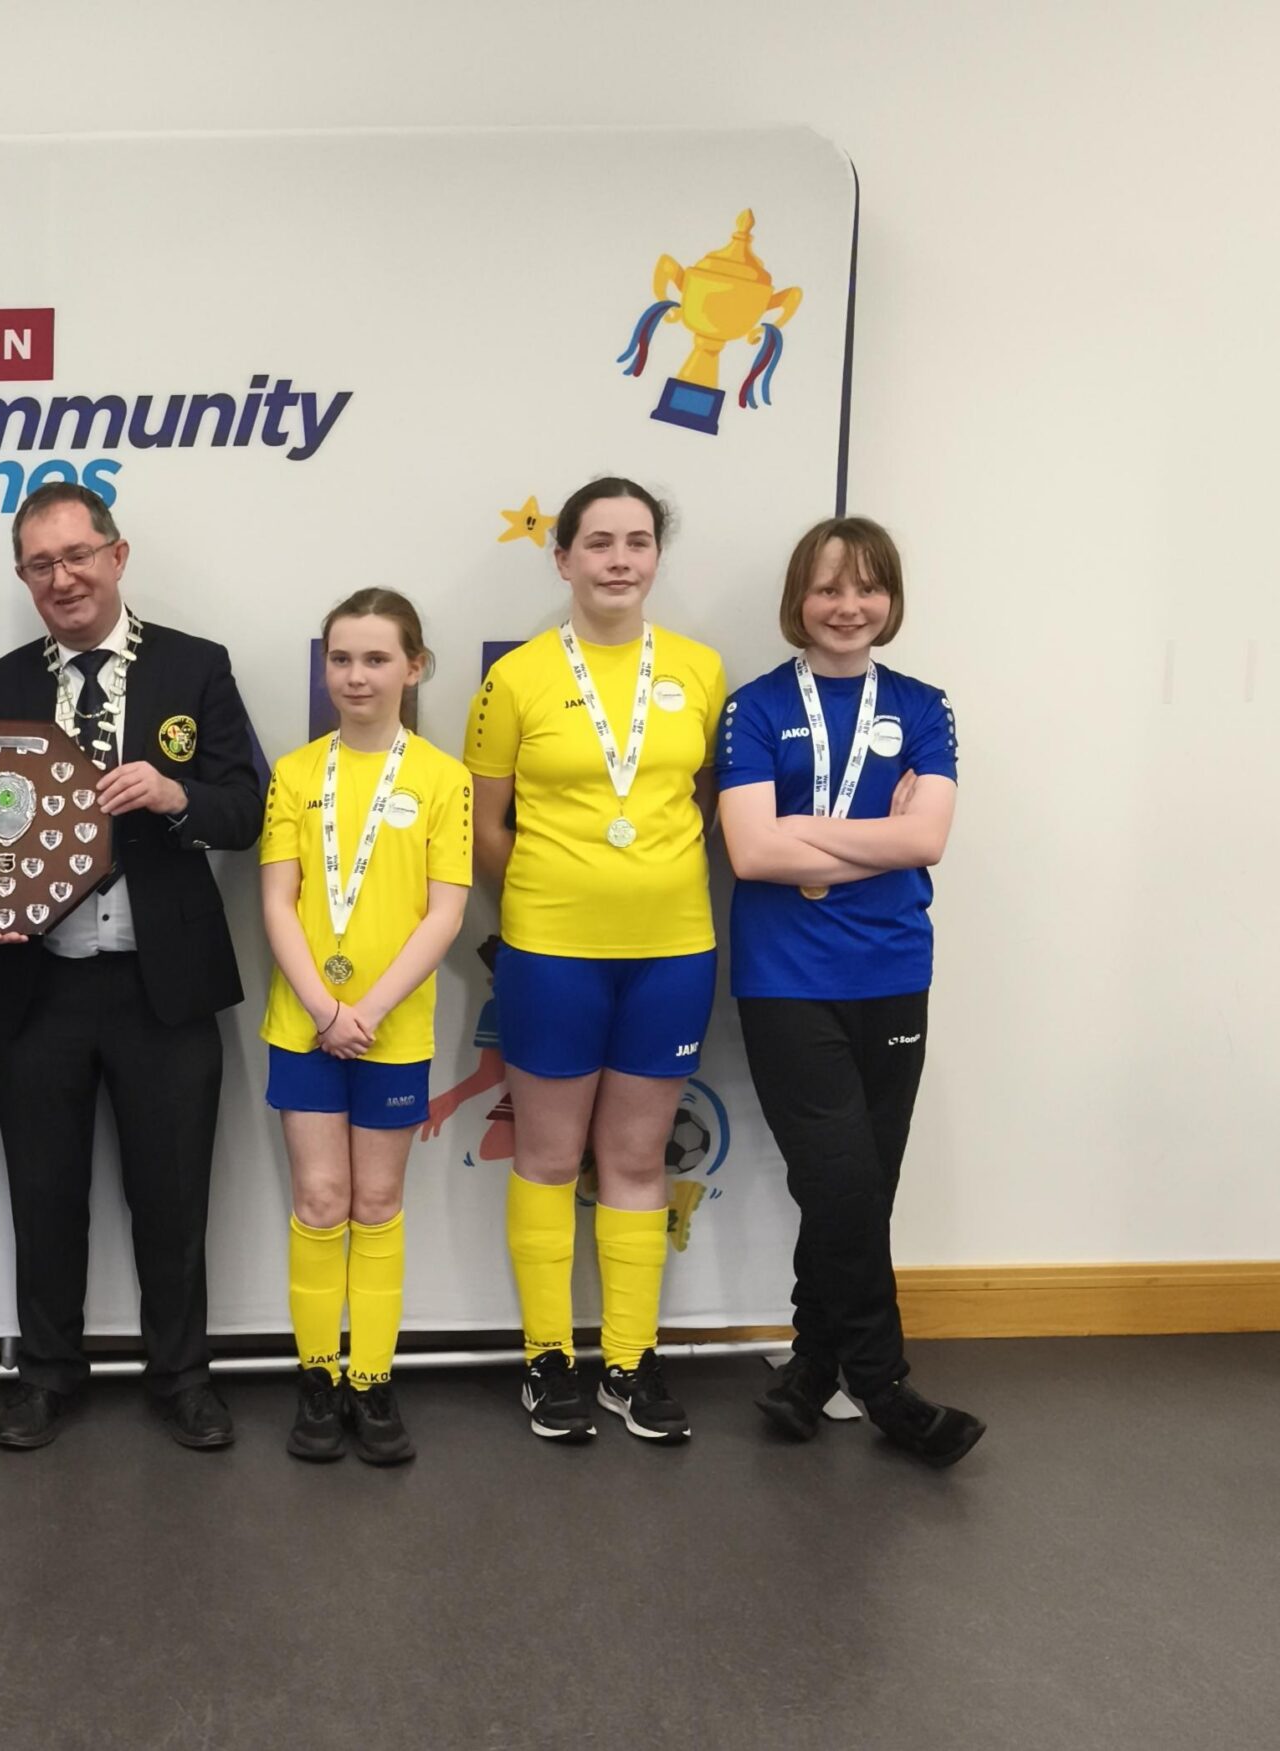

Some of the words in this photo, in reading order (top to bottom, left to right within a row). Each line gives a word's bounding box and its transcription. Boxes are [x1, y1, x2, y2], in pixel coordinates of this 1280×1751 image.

[564, 698, 587, 709] JAK
[781, 727, 810, 740] JAKO
[351, 1370, 388, 1383] JAKO
